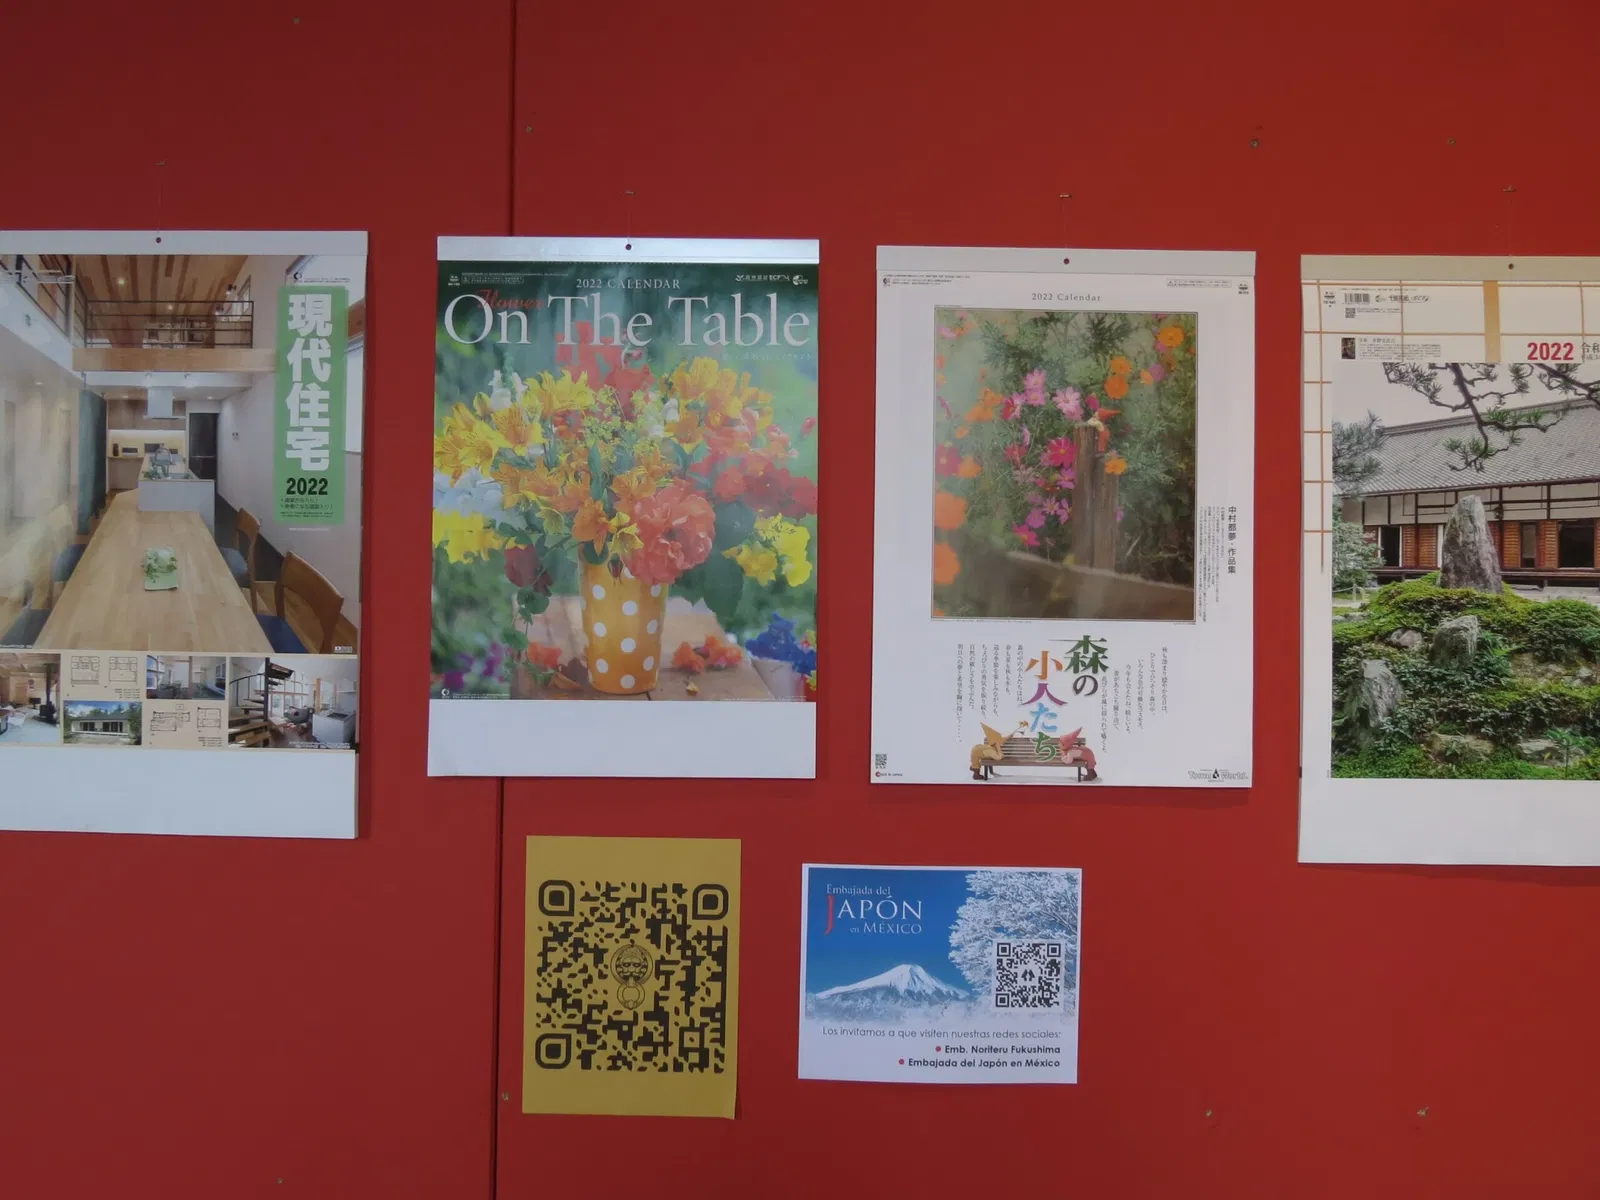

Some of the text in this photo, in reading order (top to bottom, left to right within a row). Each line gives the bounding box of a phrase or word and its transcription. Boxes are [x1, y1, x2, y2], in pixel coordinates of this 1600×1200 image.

[576, 278, 681, 290] 2022 CALENDAR
[1031, 293, 1101, 302] 2022 Calendar
[444, 292, 810, 347] On The Table
[1527, 341, 1574, 361] 2022
[285, 293, 333, 471] 現代住宅
[286, 477, 328, 496] 2022
[1049, 635, 1109, 697] 森の
[1020, 650, 1068, 762] 小人たち
[826, 883, 891, 896] Embajada del
[824, 894, 922, 936] JAPÓN
[850, 920, 922, 935] en MÉXICO
[822, 1026, 838, 1036] Los
[840, 1027, 886, 1038] invitamos
[898, 1030, 917, 1040] que
[919, 1028, 949, 1038] visiten
[951, 1029, 990, 1039] nuestras
[992, 1029, 1019, 1039] redes
[1021, 1029, 1061, 1039] sociales:
[945, 1045, 1061, 1055] Emb. Noriteru Fukushima
[908, 1058, 1060, 1069] Embajada del Japón en México
